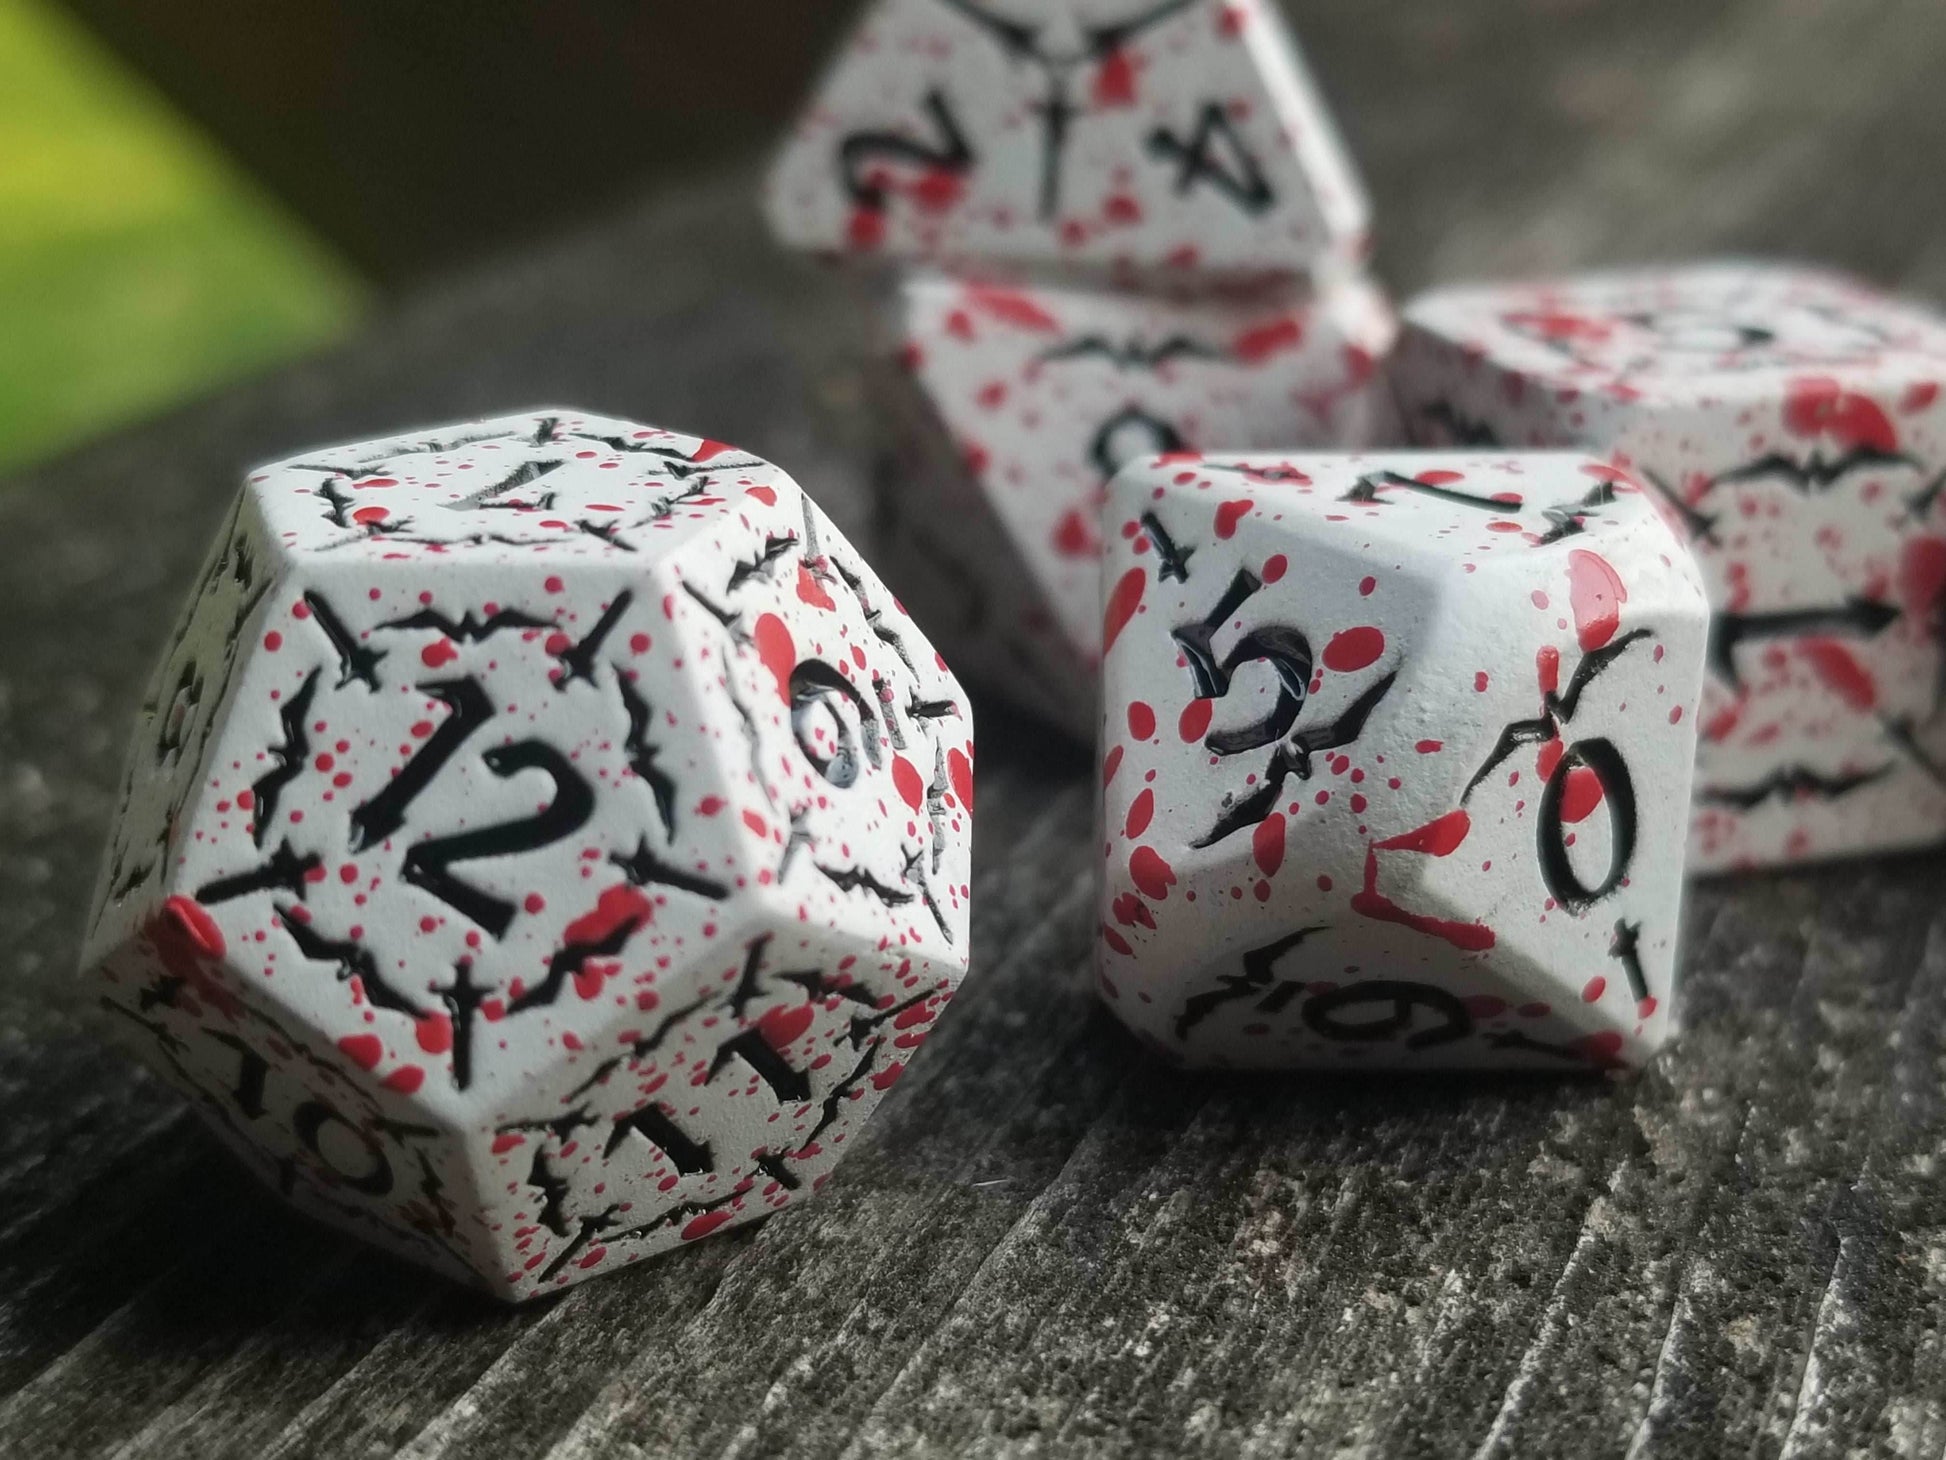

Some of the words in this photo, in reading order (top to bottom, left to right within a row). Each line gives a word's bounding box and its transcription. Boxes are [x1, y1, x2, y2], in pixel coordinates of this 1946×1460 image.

[838, 92, 974, 210] 2
[1144, 100, 1276, 216] 4
[1170, 568, 1313, 756] 5
[350, 676, 597, 942] 12
[1536, 737, 1637, 917] 0
[200, 1026, 394, 1195] 10
[603, 1027, 811, 1177] 11
